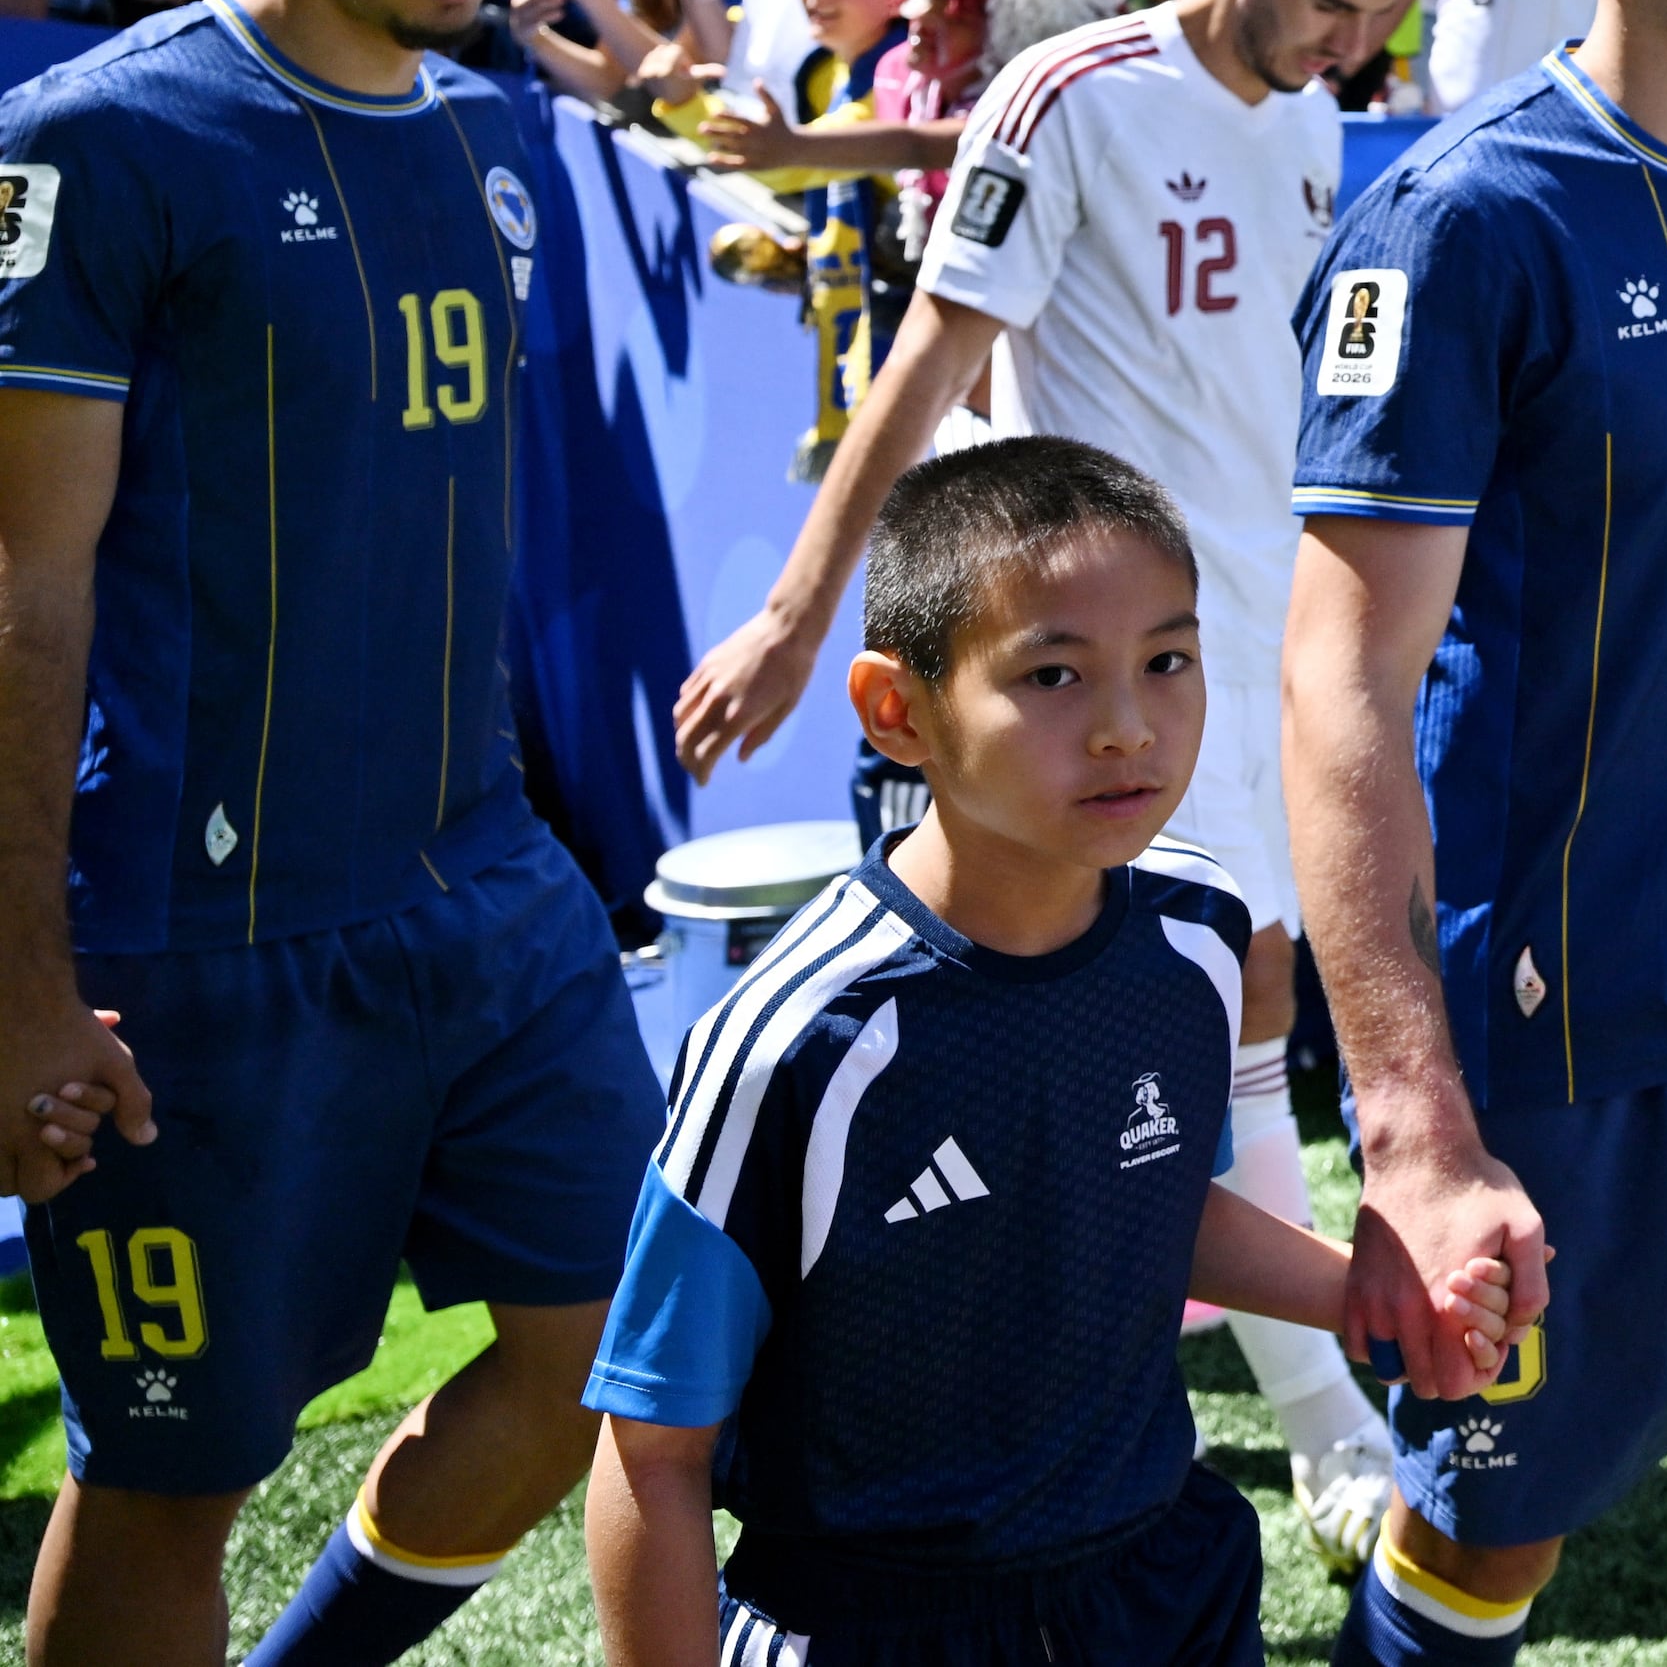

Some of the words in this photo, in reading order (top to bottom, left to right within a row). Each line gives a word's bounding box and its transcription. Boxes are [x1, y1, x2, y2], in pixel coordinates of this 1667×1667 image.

[281, 227, 337, 243] KELME
[1159, 216, 1239, 317] 12
[398, 288, 488, 431] 19
[1332, 373, 1371, 383] 2026
[1120, 1117, 1177, 1150] QUAKER
[1120, 1154, 1151, 1170] PLAYER
[1151, 1144, 1180, 1160] ESCORT
[76, 1226, 210, 1362] 19
[128, 1405, 189, 1421] KELME
[1448, 1451, 1519, 1470] KELME
